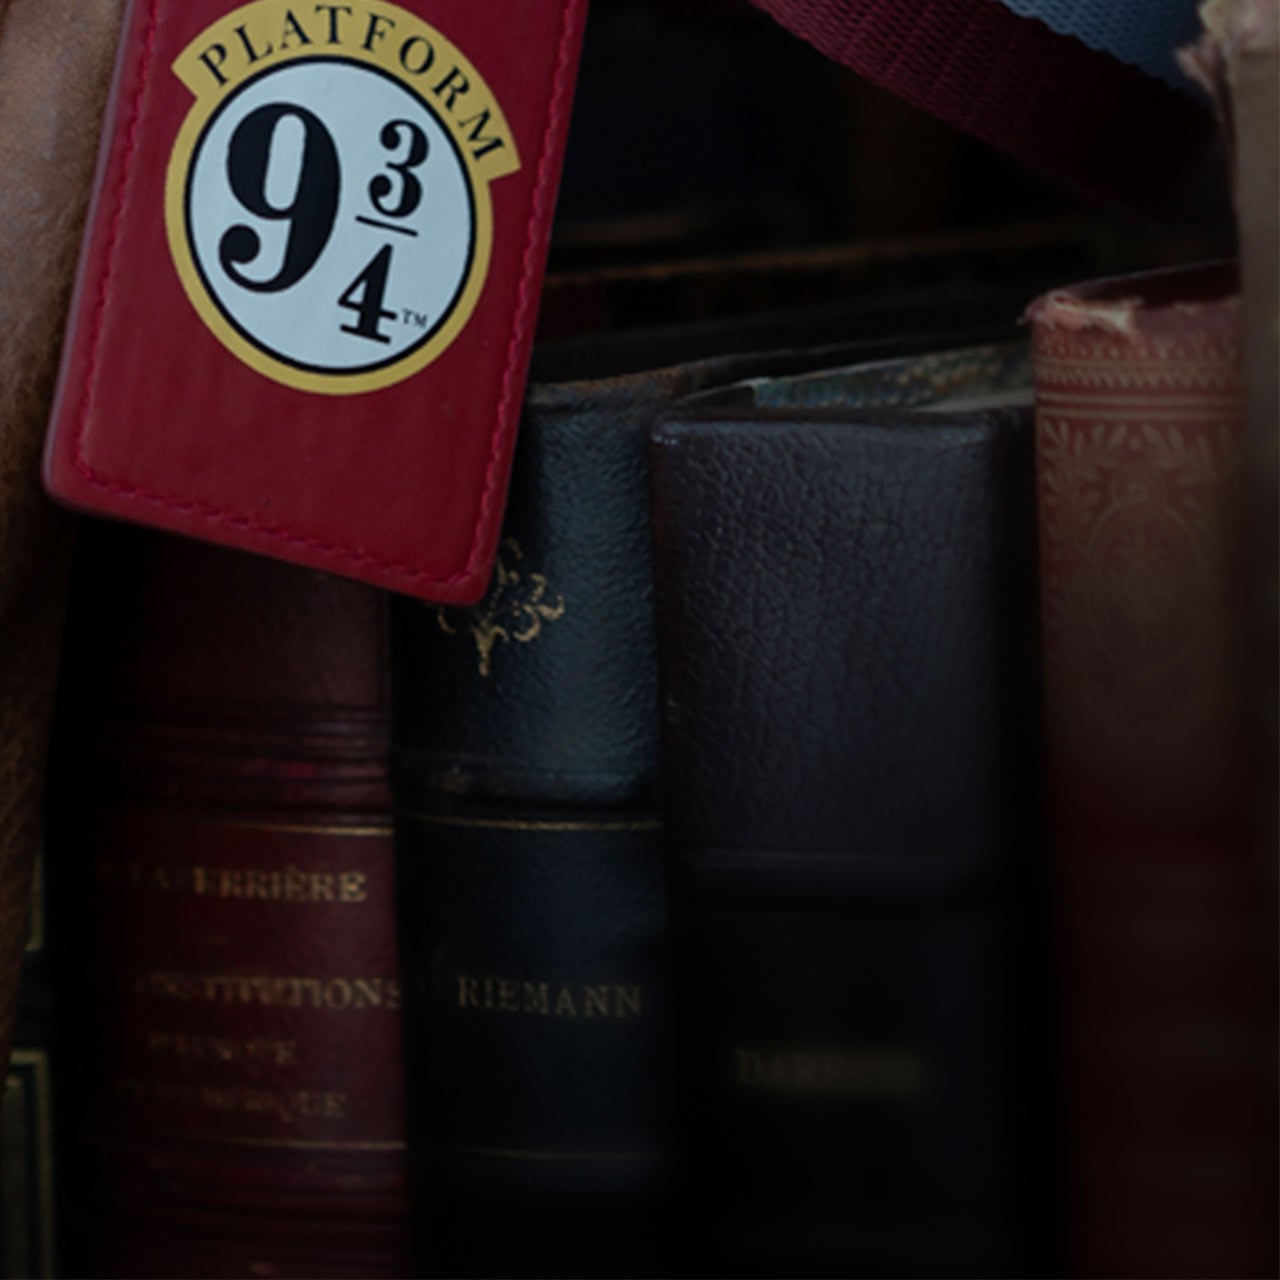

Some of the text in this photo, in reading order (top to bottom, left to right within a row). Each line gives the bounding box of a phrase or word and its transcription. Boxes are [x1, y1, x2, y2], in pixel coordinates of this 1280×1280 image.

[197, 5, 506, 162] PLATFORM
[219, 102, 341, 294] 9
[368, 119, 429, 219] 3
[337, 243, 398, 345] 4
[457, 973, 643, 1018] RIEMANN
